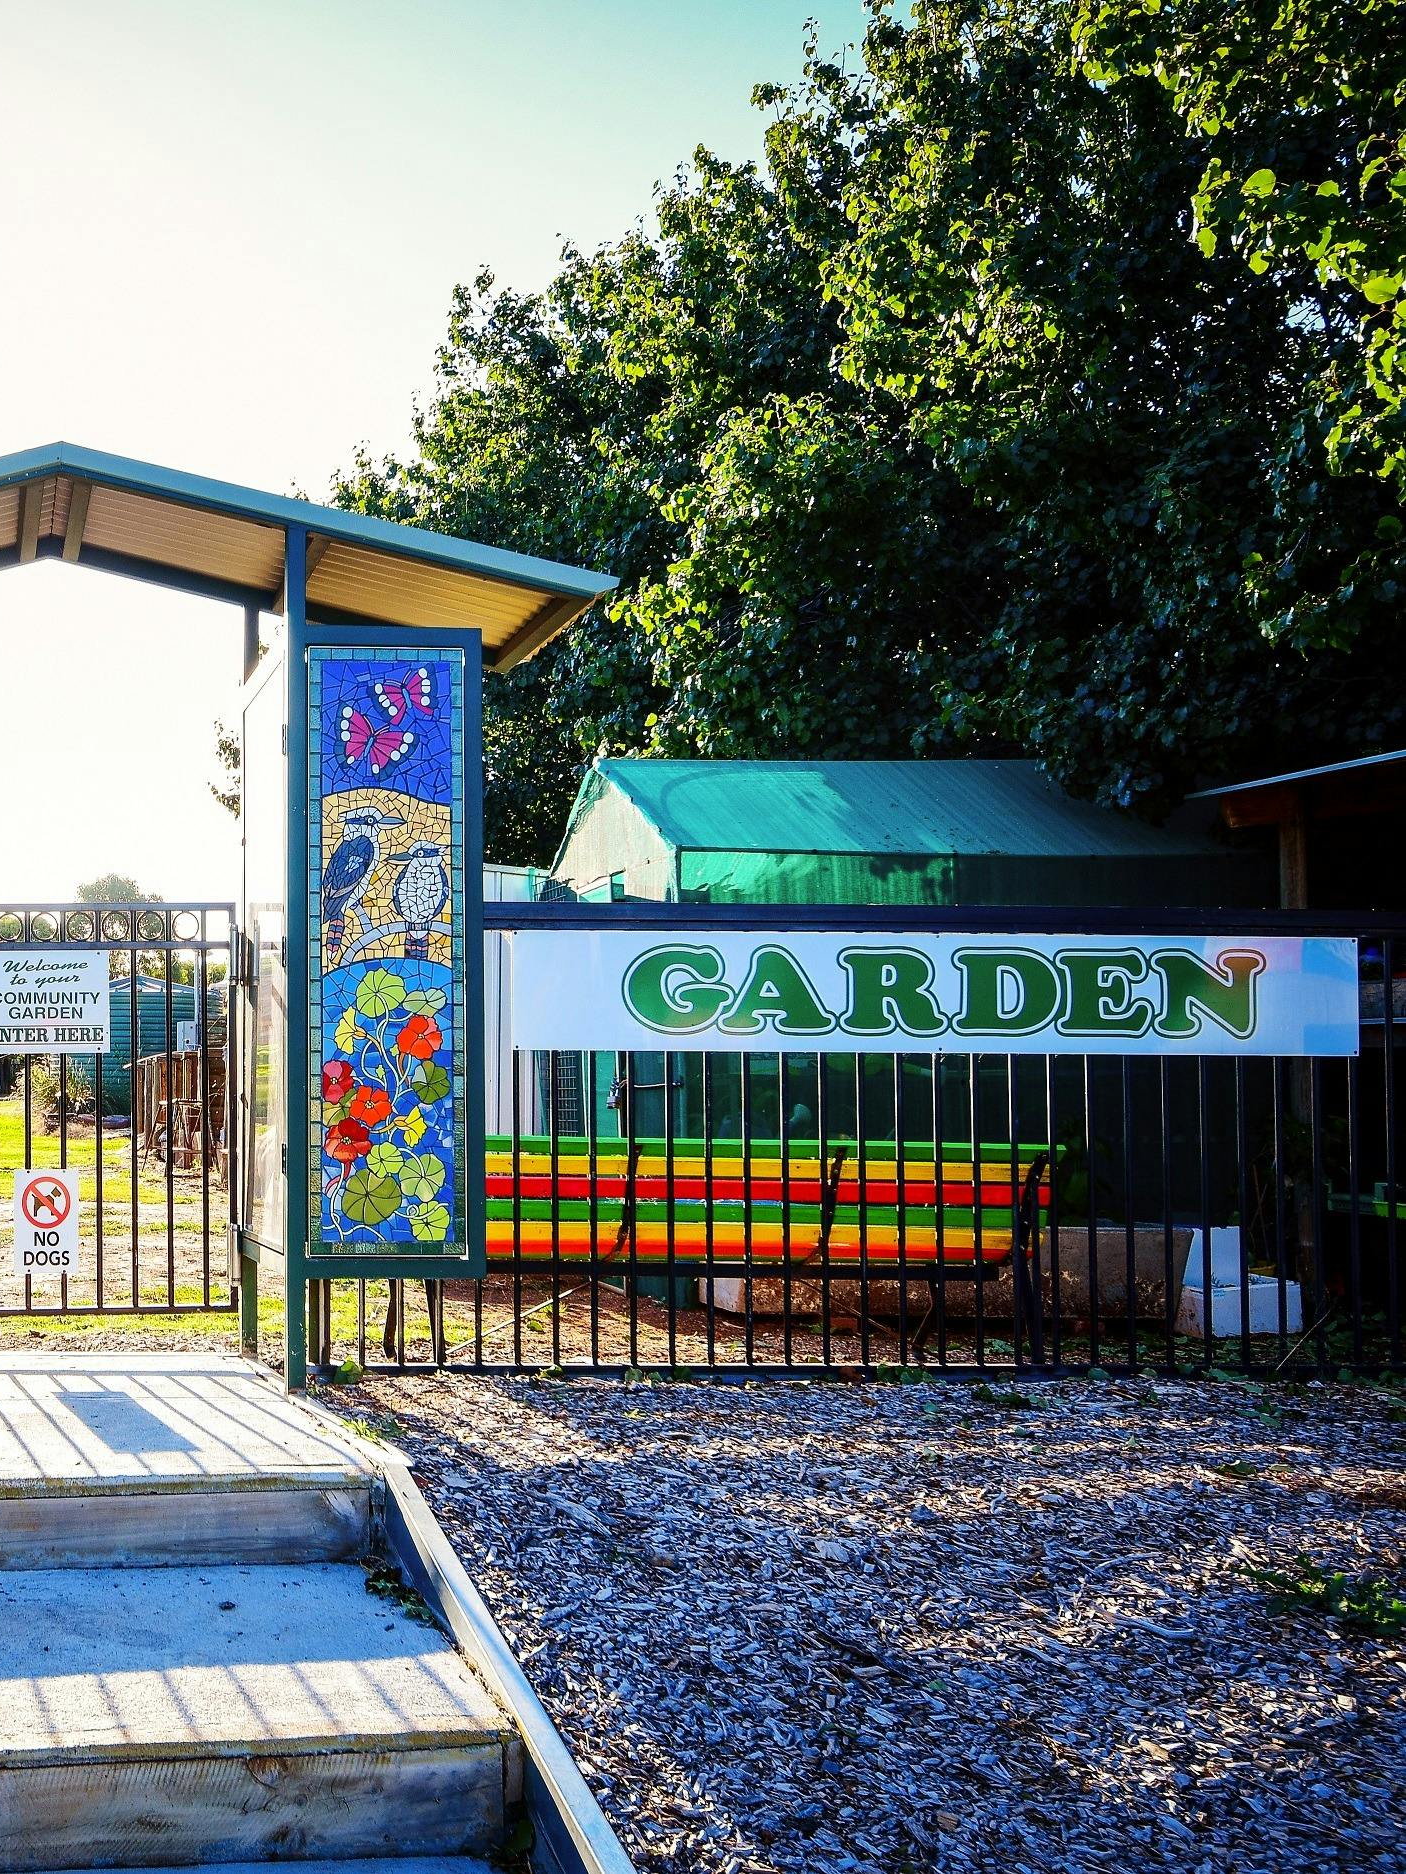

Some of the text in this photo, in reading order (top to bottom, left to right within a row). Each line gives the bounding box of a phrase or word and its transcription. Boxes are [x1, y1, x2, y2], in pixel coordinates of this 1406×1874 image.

[2, 958, 88, 973] Welcome
[10, 973, 81, 988] to your
[621, 943, 1267, 1040] GARDEN
[8, 1006, 83, 1020] GARDEN
[54, 1027, 104, 1042] HERE
[34, 1231, 60, 1247] NO
[23, 1250, 70, 1266] DOGS
